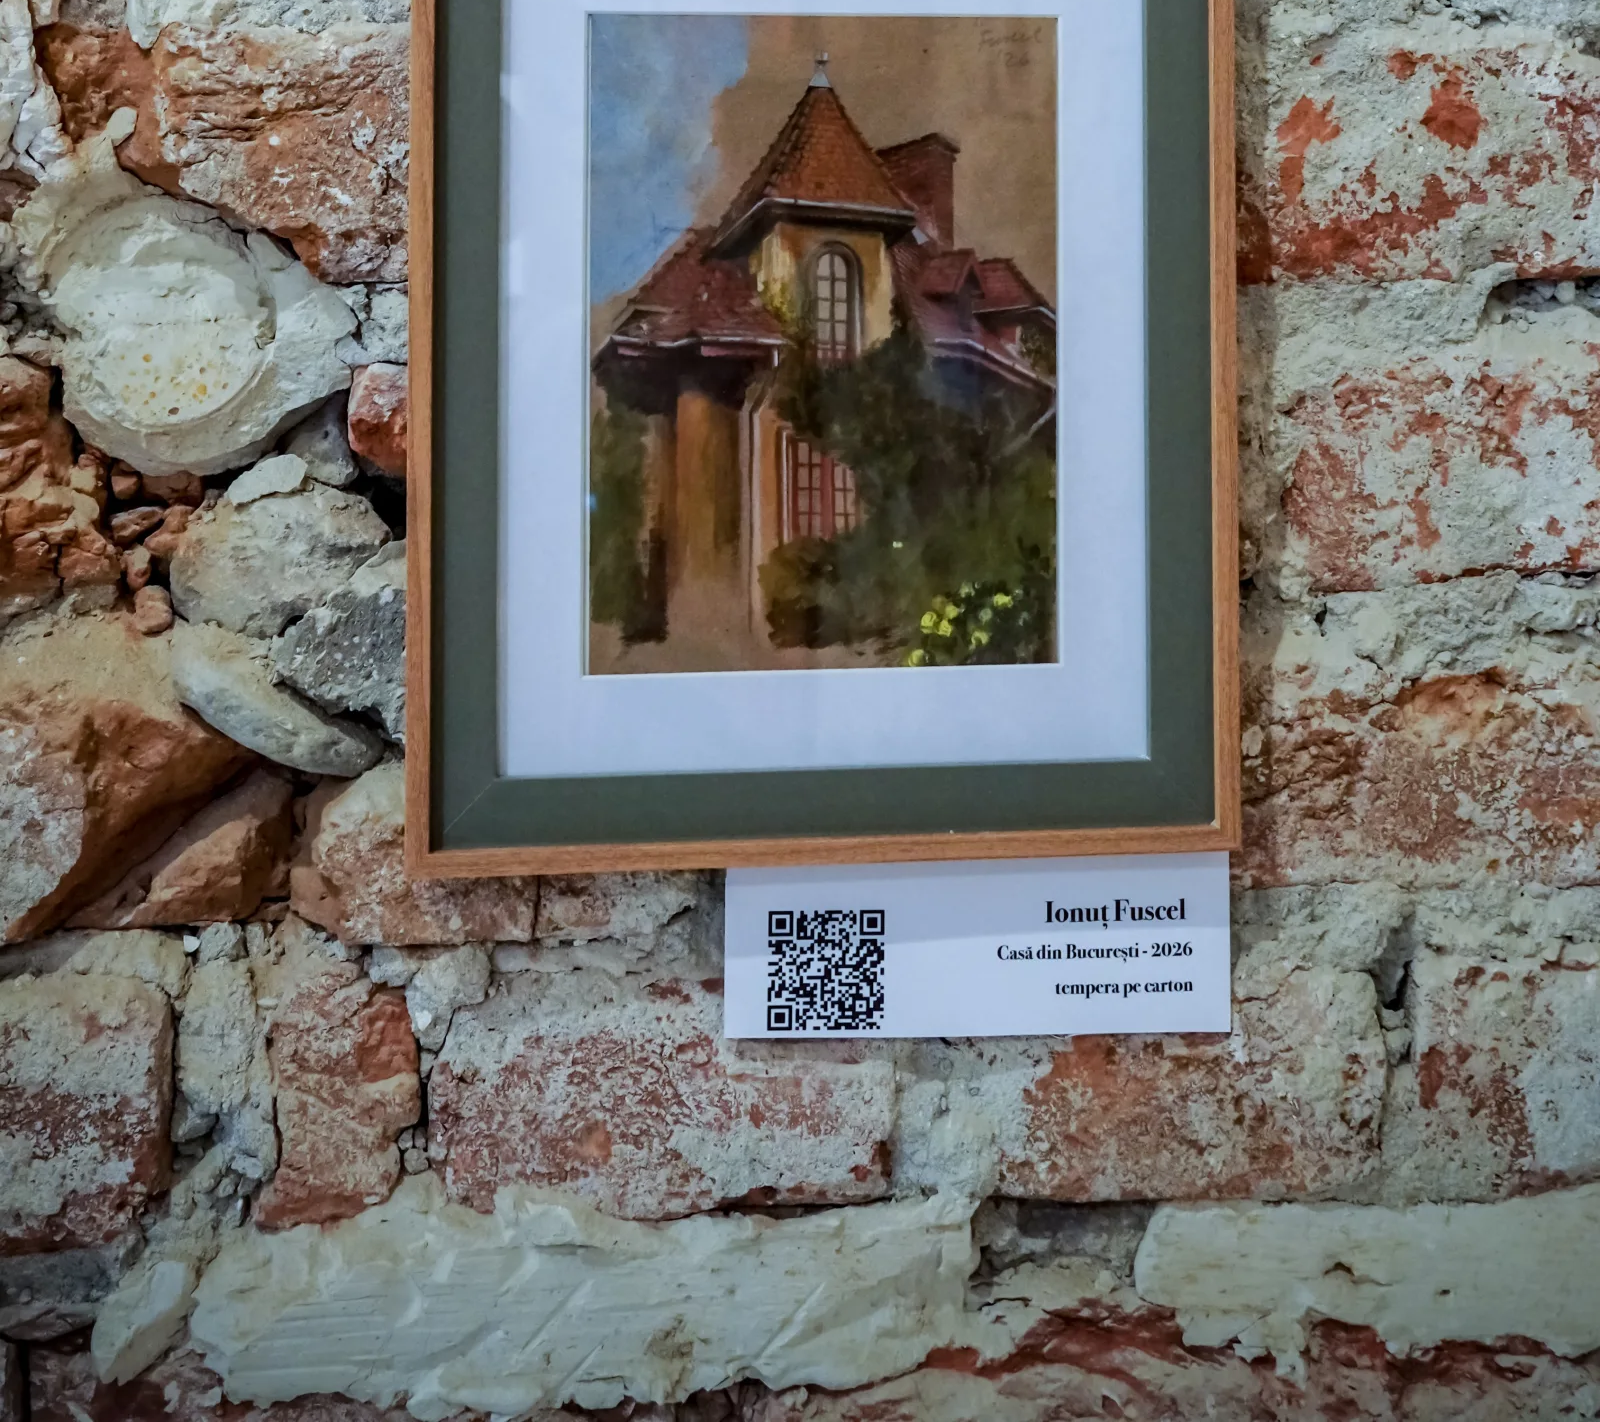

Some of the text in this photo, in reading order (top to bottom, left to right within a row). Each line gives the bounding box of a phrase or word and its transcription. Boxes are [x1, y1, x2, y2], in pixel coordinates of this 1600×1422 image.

[1045, 898, 1187, 930] Ionuț Fuscel
[996, 944, 1033, 961] Casă
[1036, 944, 1062, 960] din
[1066, 942, 1140, 964] București
[1151, 941, 1193, 957] 2026
[1055, 980, 1193, 999] tempera pe carton
